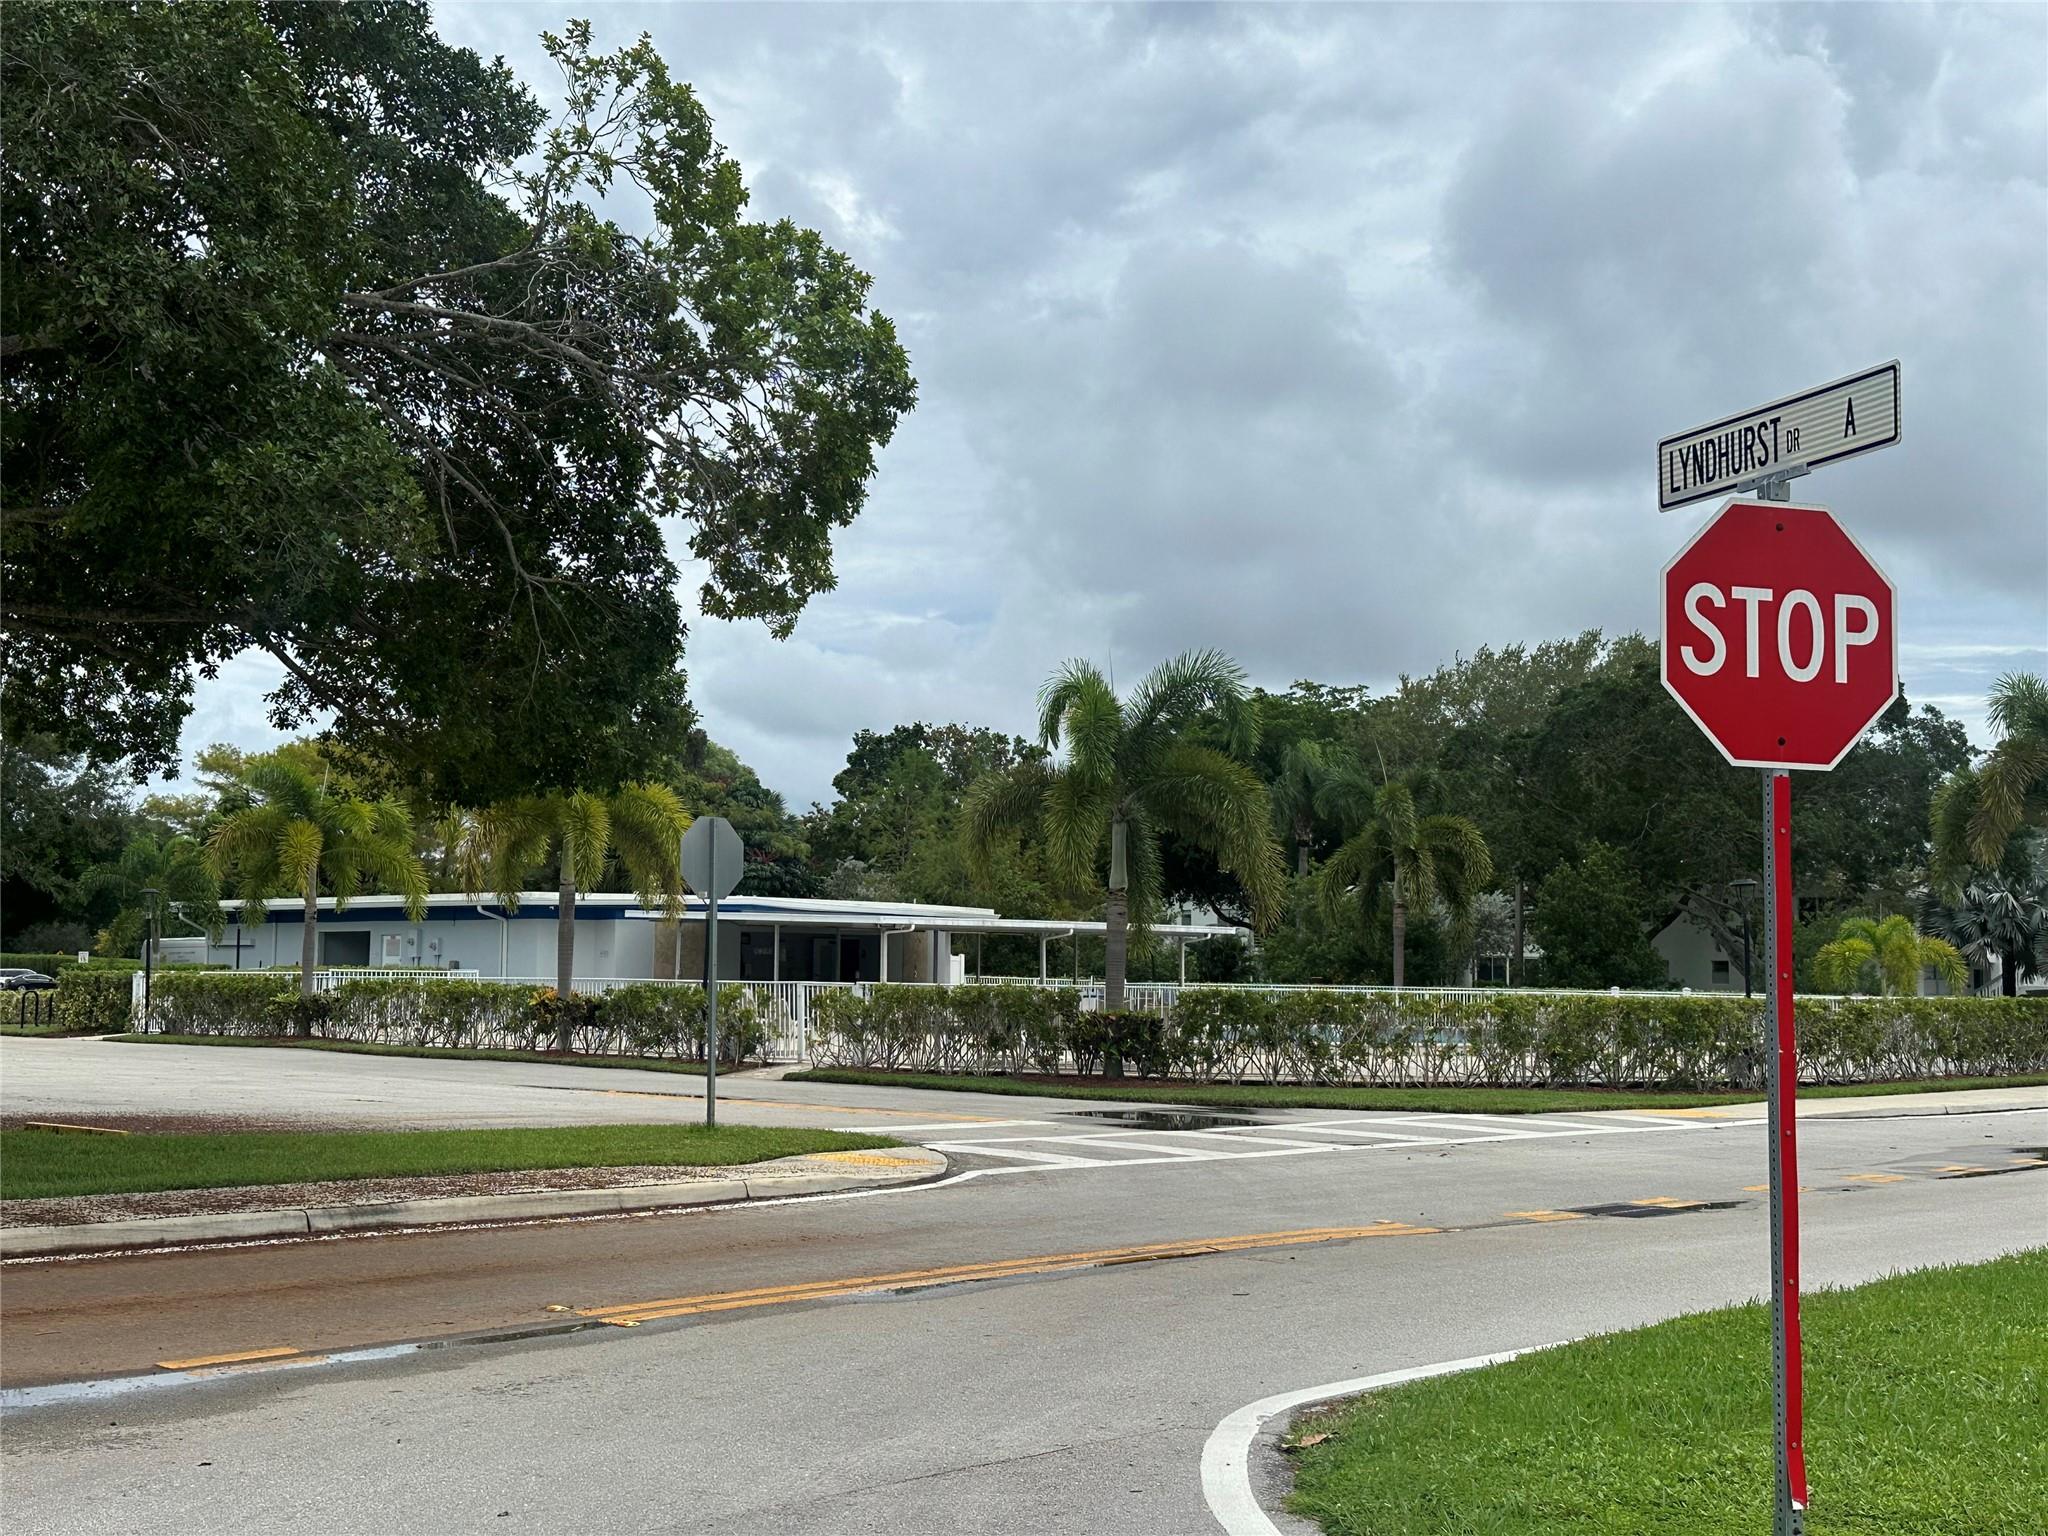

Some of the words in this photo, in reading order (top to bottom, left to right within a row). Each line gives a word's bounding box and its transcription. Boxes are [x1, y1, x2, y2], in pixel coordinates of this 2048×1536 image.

[1669, 416, 1781, 494] LYNDHURST
[1786, 428, 1800, 453] DR
[1844, 396, 1857, 438] A
[1680, 582, 1880, 684] STOP
